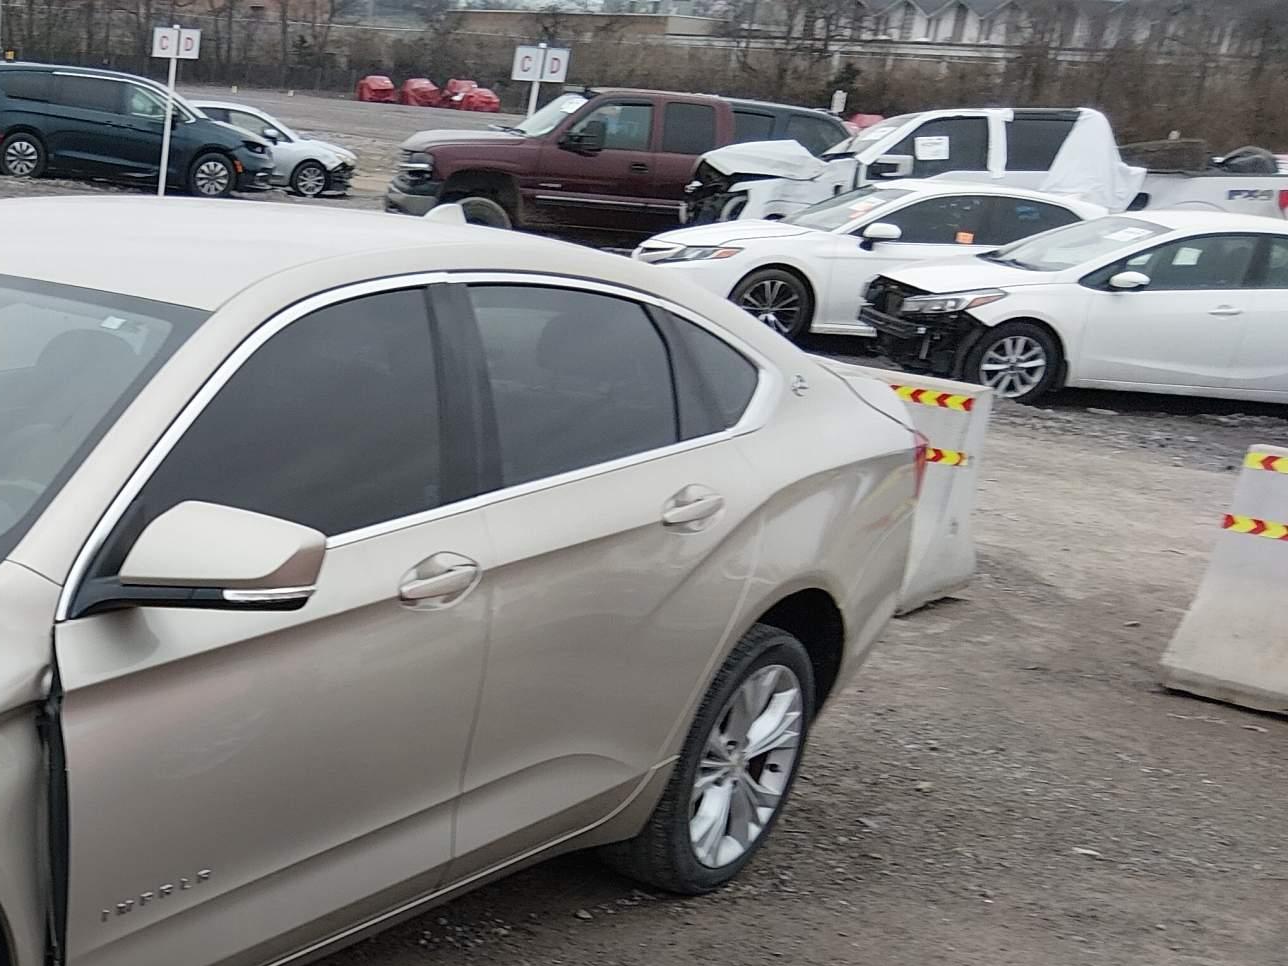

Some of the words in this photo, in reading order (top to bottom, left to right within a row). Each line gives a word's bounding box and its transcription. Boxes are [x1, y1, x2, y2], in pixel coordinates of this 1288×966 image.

[160, 35, 169, 51] C
[183, 36, 194, 52] D
[520, 55, 532, 73] C
[550, 57, 561, 74] D
